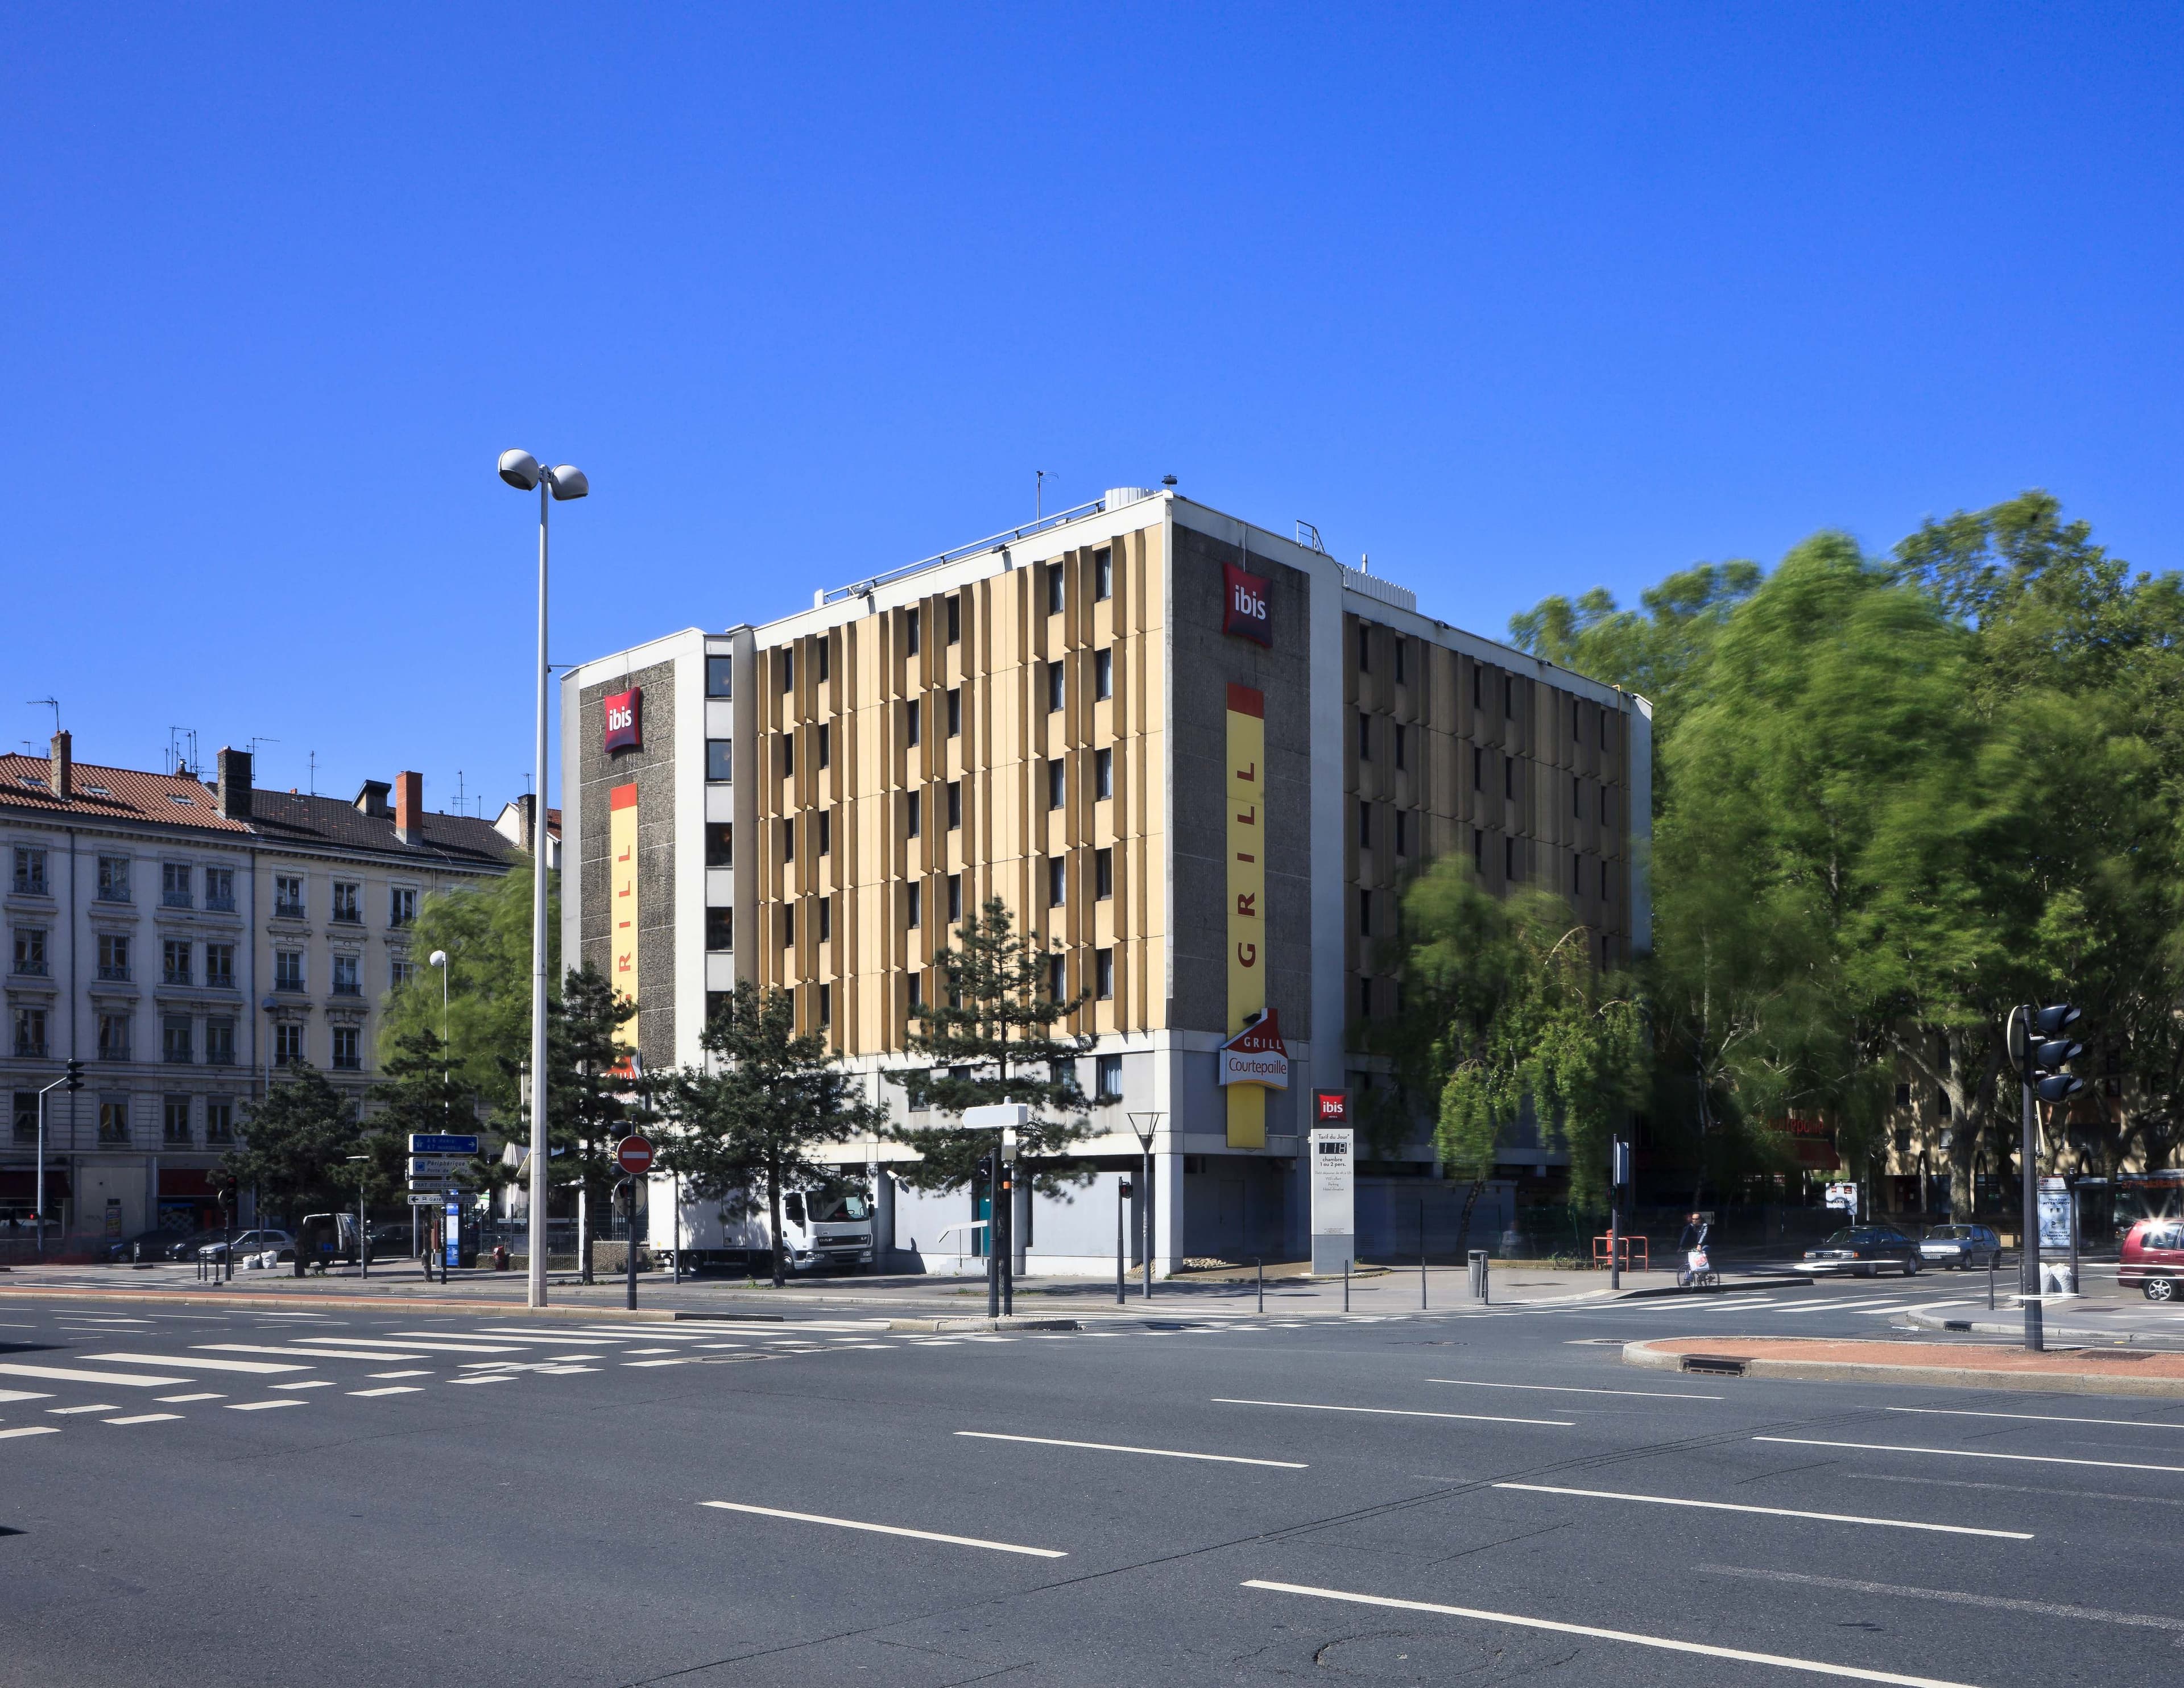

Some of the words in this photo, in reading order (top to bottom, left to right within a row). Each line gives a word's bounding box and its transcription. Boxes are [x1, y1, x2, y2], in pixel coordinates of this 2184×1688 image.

[1235, 585, 1266, 620] ibis
[609, 706, 632, 731] ibis
[1236, 762, 1256, 968] GRILL
[1244, 1037, 1281, 1049] GRILL
[1229, 1057, 1287, 1075] Courtepaille
[1323, 1101, 1343, 1113] ibis
